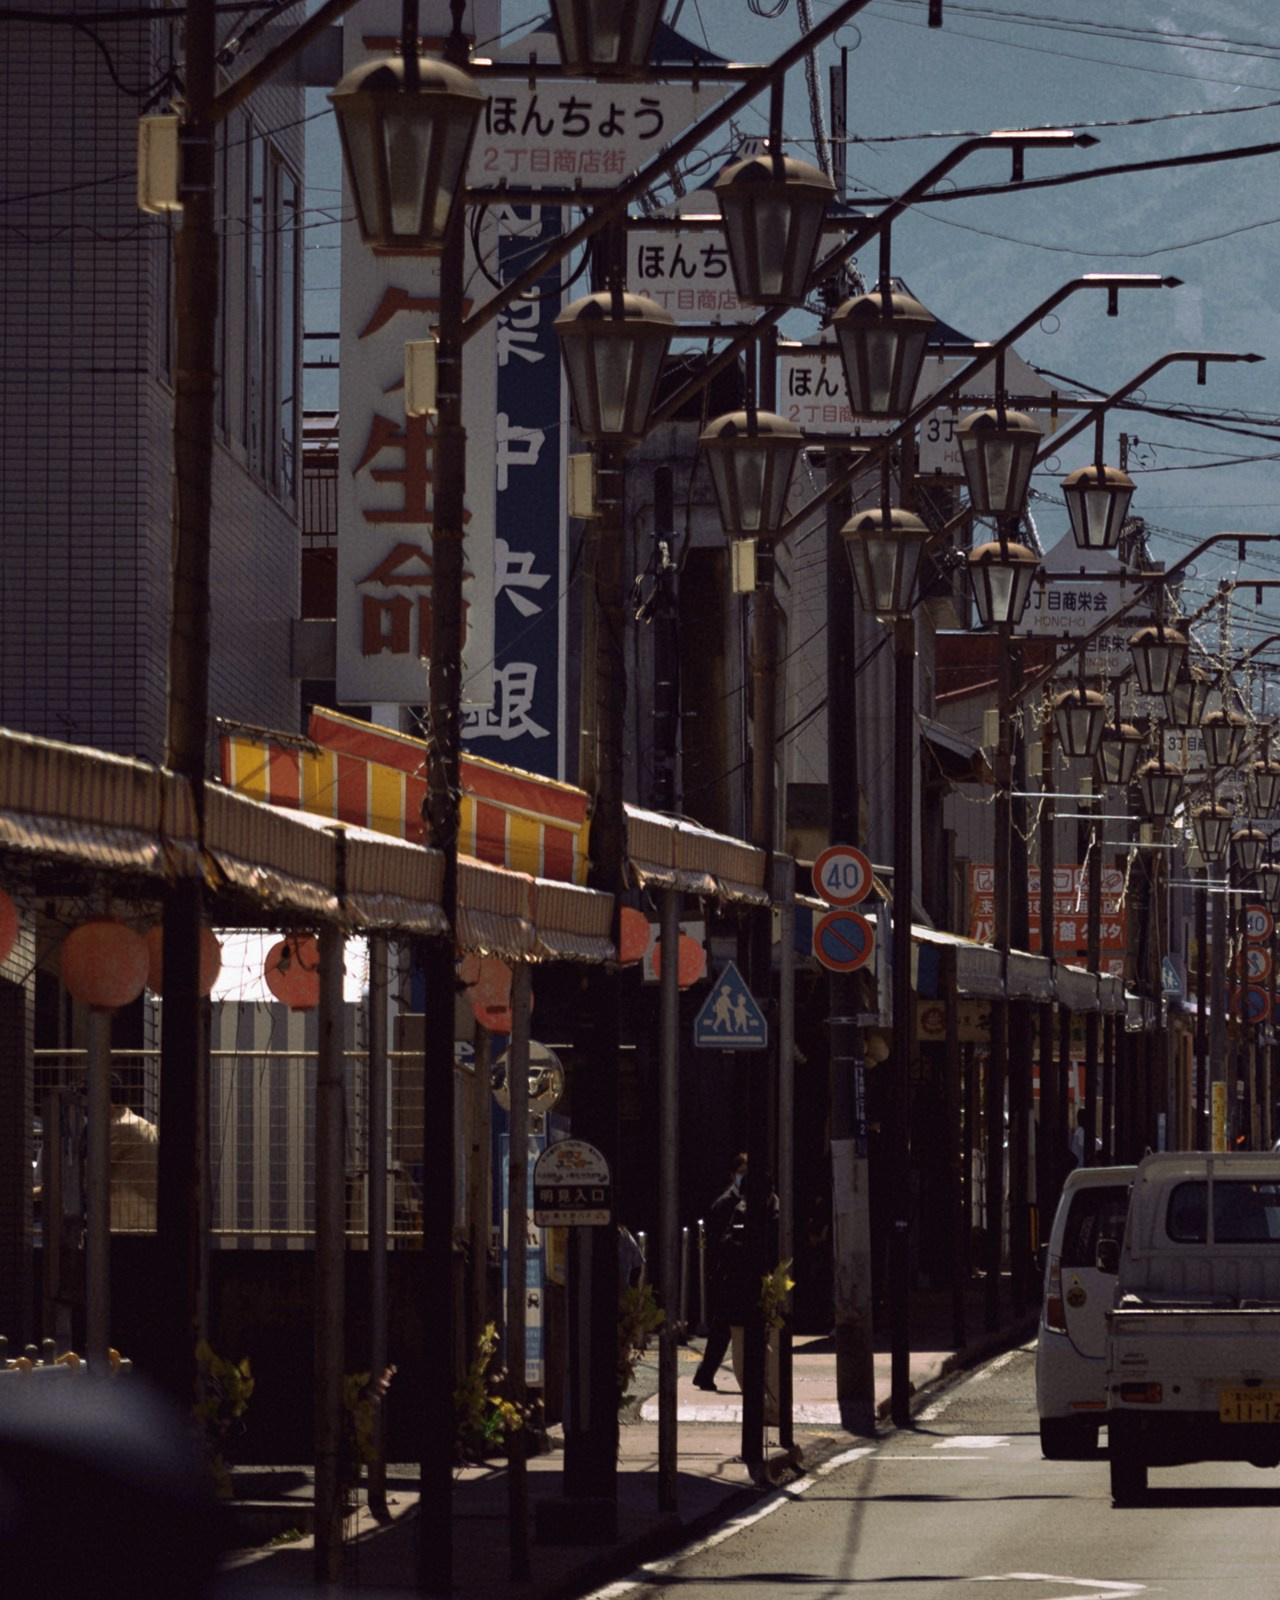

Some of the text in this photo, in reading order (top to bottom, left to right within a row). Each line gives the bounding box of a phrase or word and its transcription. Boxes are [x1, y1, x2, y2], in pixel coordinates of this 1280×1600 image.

[485, 95, 664, 139] ほんちょう
[484, 147, 626, 175] 2丁目商店街
[638, 243, 728, 279] ほんち
[827, 863, 859, 890] 40
[1246, 916, 1265, 931] 40
